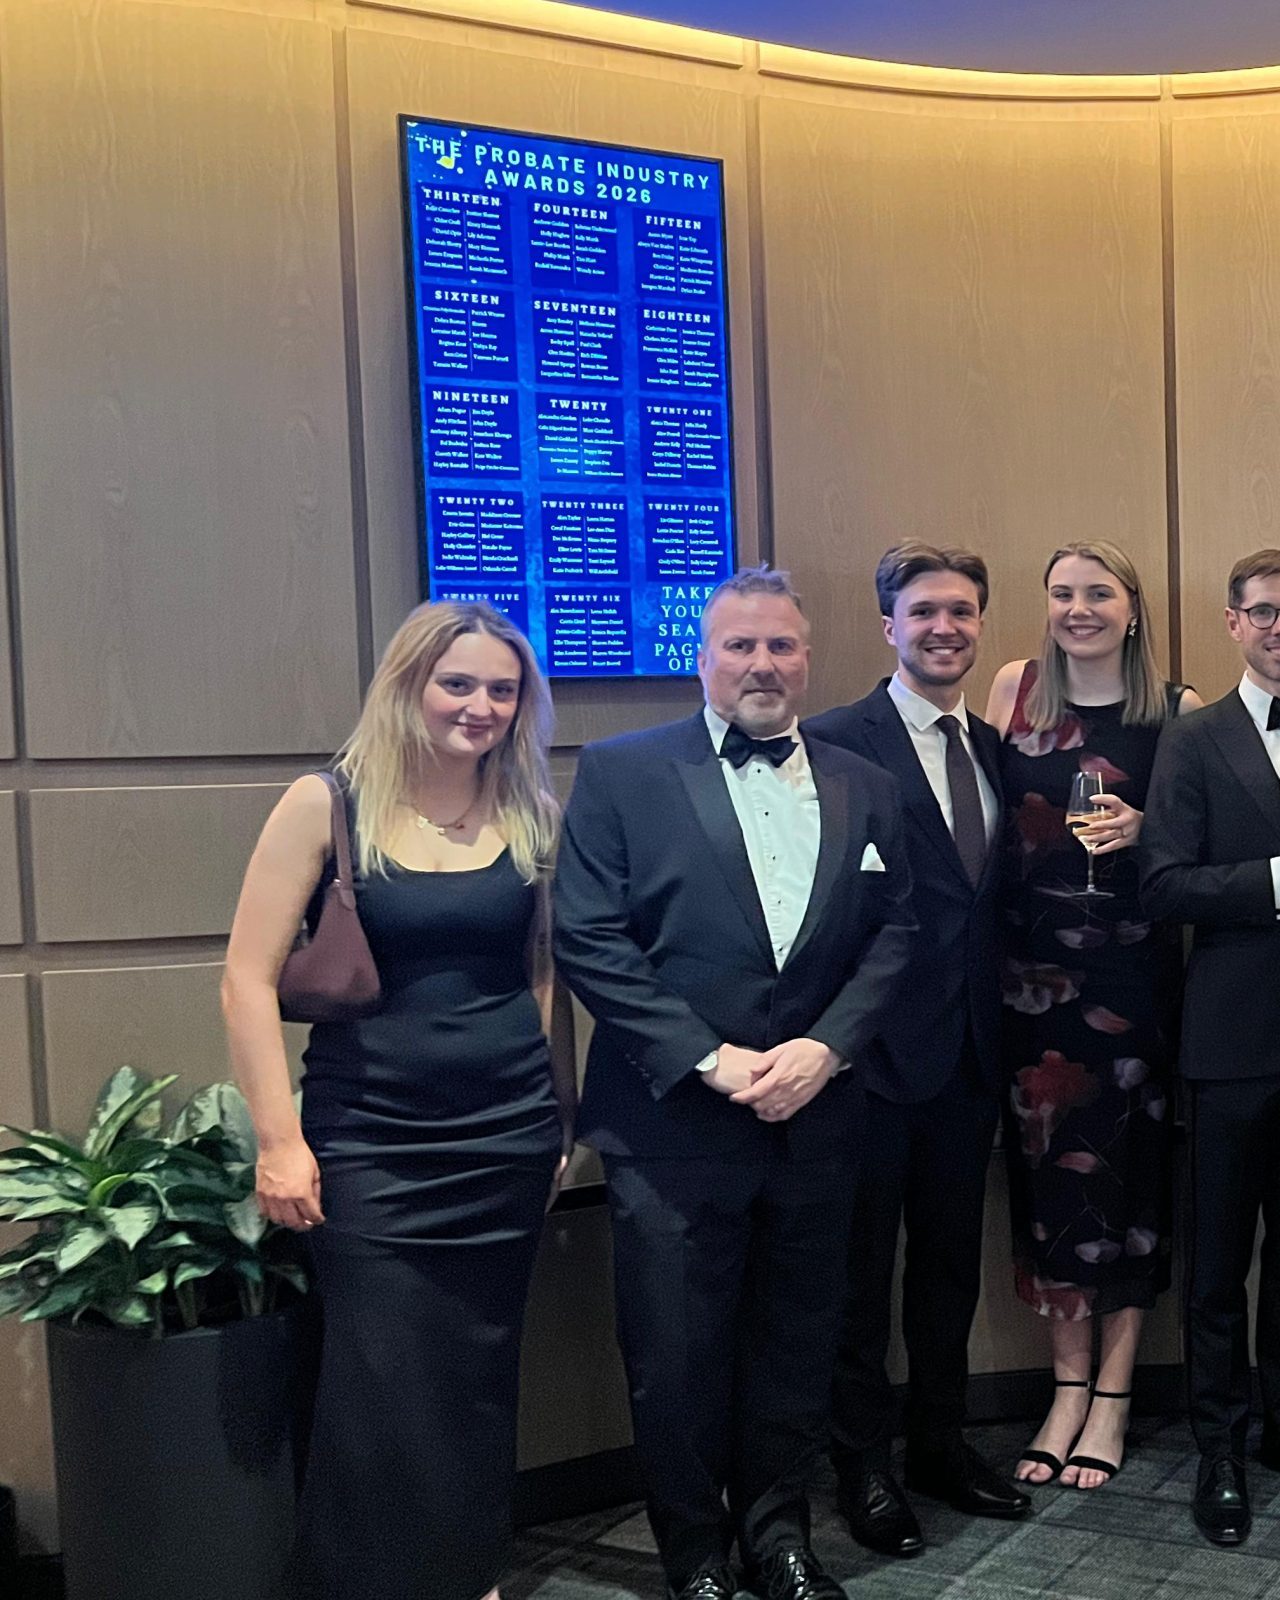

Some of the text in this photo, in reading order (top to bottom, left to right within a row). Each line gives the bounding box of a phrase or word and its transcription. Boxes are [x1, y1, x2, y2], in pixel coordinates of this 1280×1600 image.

[415, 136, 710, 190] THE PROBATE INDUSTRY
[484, 169, 651, 204] AWARDS 2026
[423, 188, 500, 207] THIRTEEN
[534, 203, 608, 220] FOURTEEN
[646, 215, 701, 230] FIFTEEN
[435, 290, 499, 305] SIXTEEN
[534, 300, 616, 316] SEVENTEEN
[643, 309, 710, 323] EIGHTEEN
[432, 391, 509, 404] NINETEEN
[549, 399, 607, 411] TWENTY
[646, 406, 688, 415] TWENTY
[438, 496, 514, 506] TWENTY TWO
[542, 501, 624, 510] TWENTY THREE
[648, 503, 719, 512] TWENTY FOUR
[494, 593, 519, 601] FIVE
[555, 594, 598, 602] TWENTY
[661, 605, 702, 618] YOU
[658, 623, 696, 636] SEA
[654, 643, 702, 656] PAG
